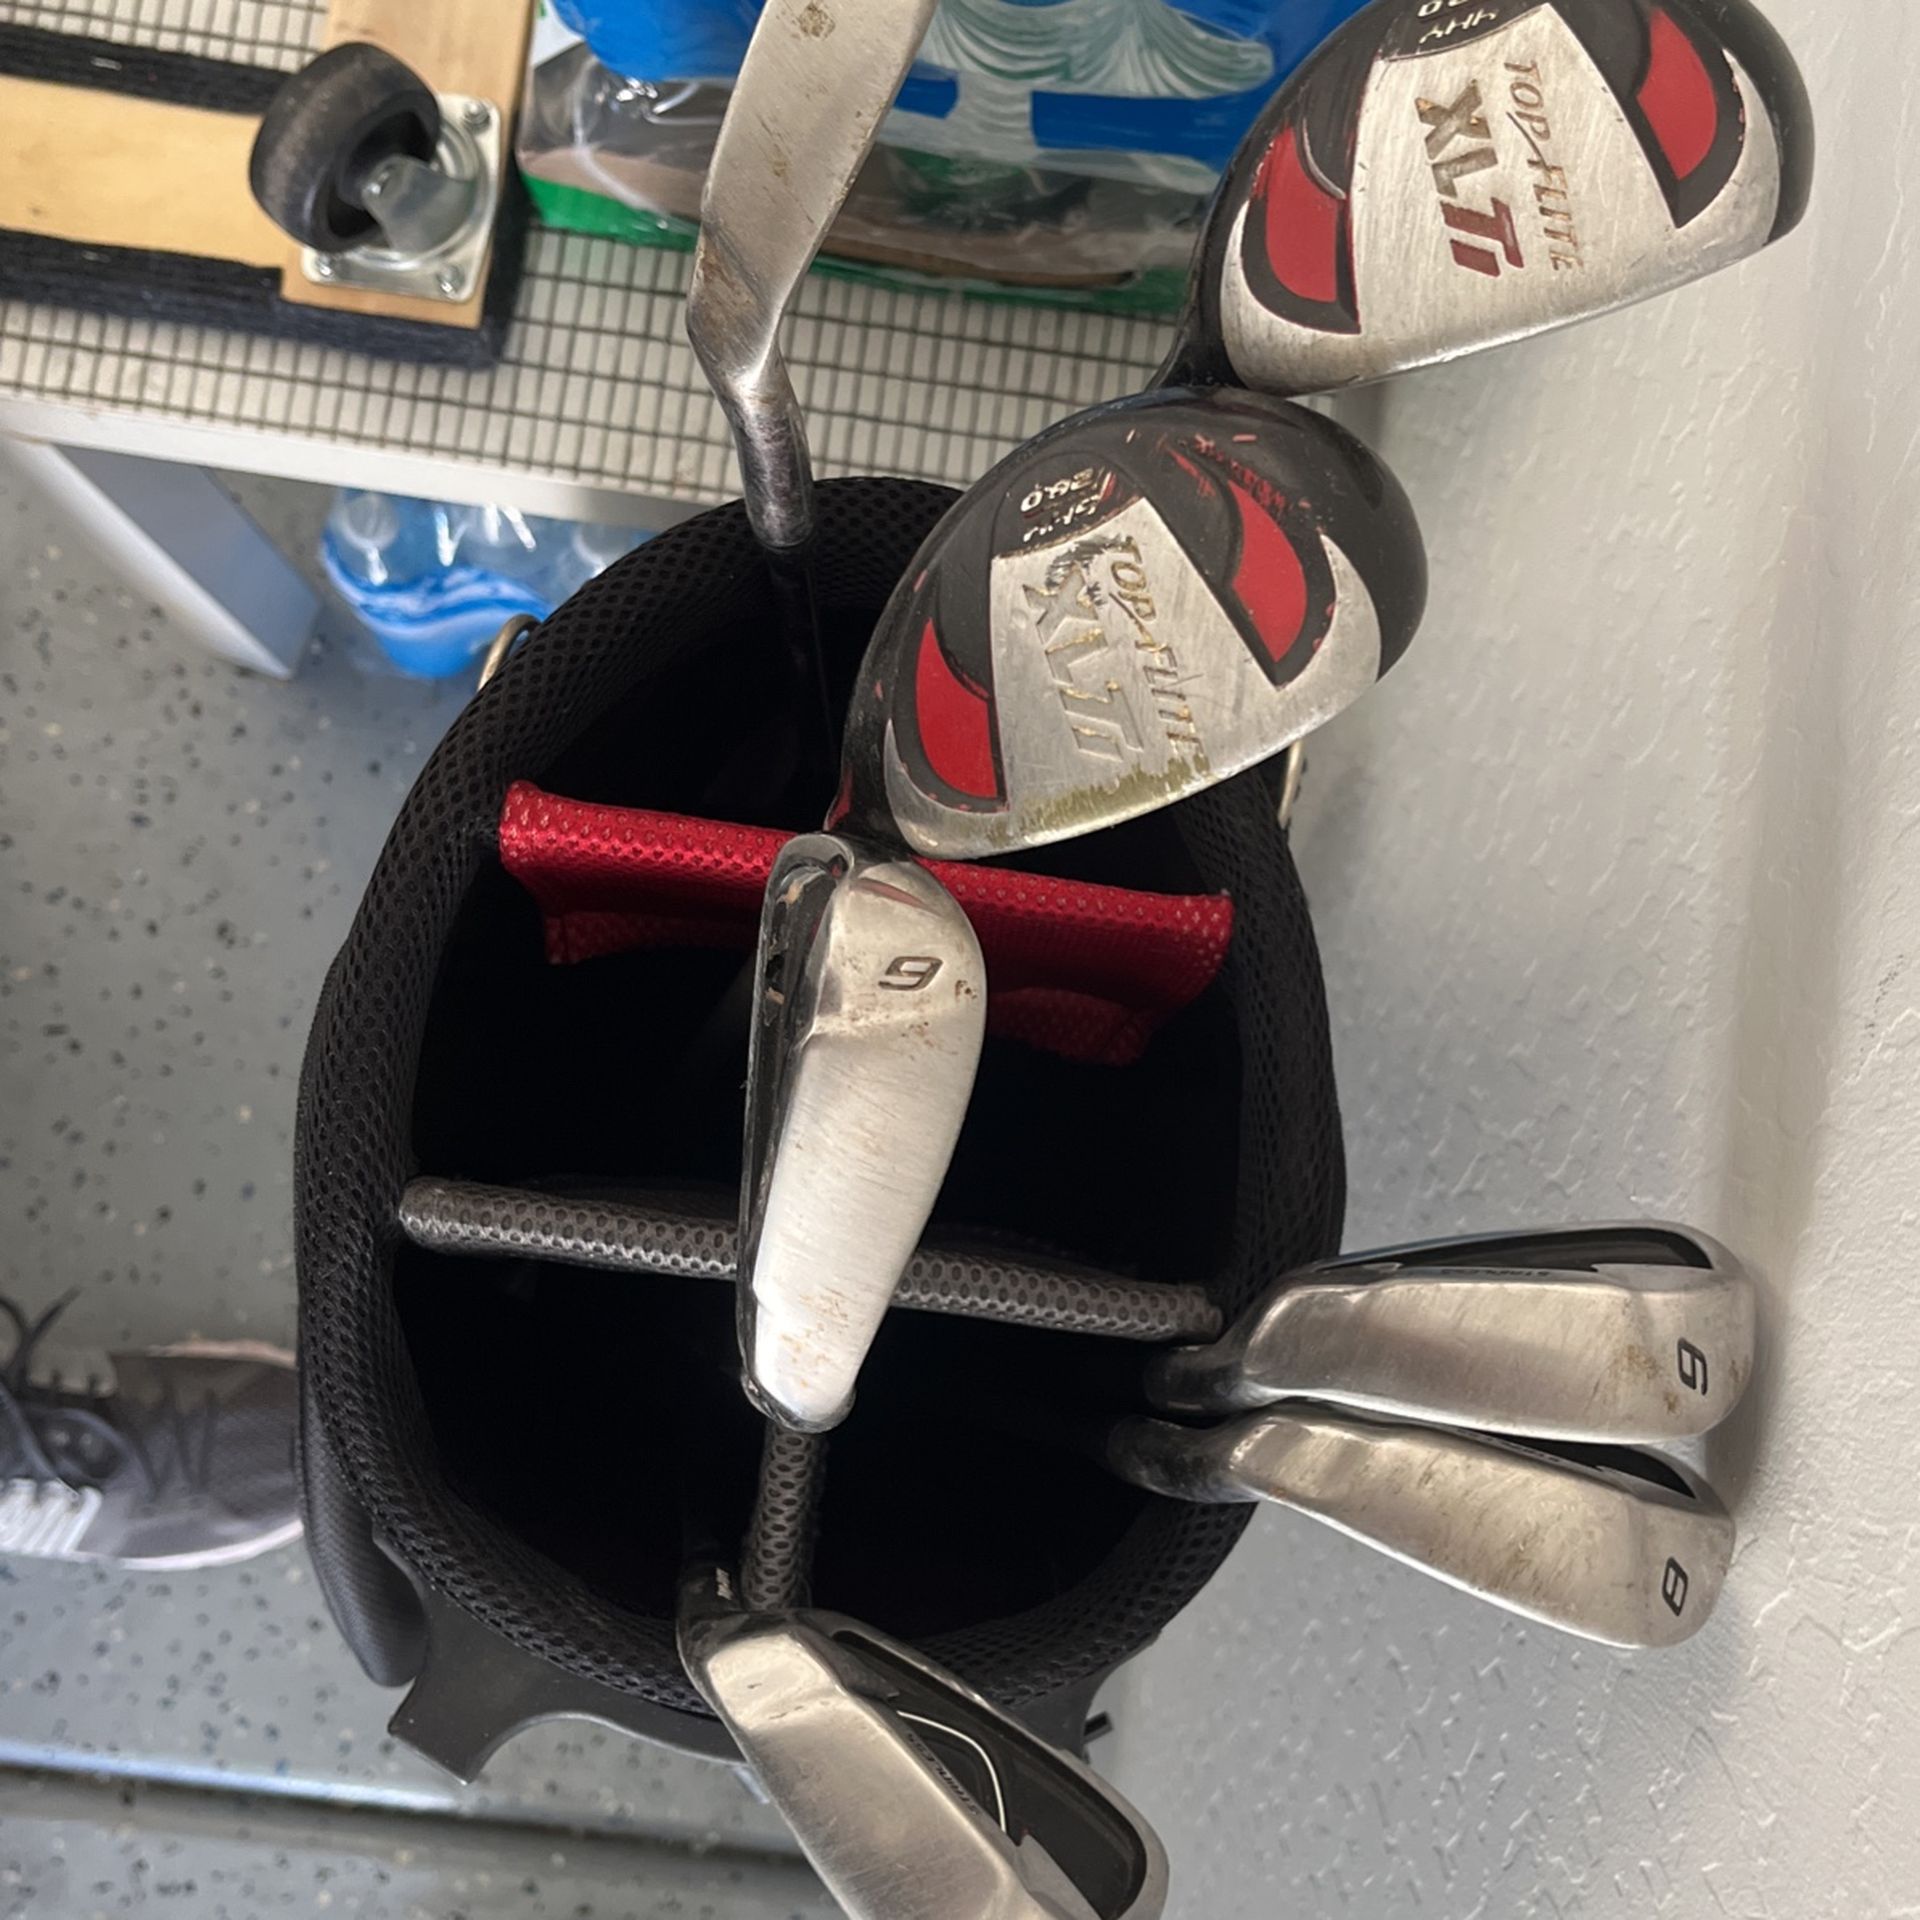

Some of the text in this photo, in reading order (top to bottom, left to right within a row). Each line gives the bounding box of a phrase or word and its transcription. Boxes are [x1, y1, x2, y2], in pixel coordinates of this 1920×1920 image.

[1504, 60, 1550, 141] TOP
[1105, 535, 1156, 622] TOP
[878, 955, 944, 992] 9
[1677, 1336, 1708, 1396] 6
[1662, 1556, 1689, 1617] 8
